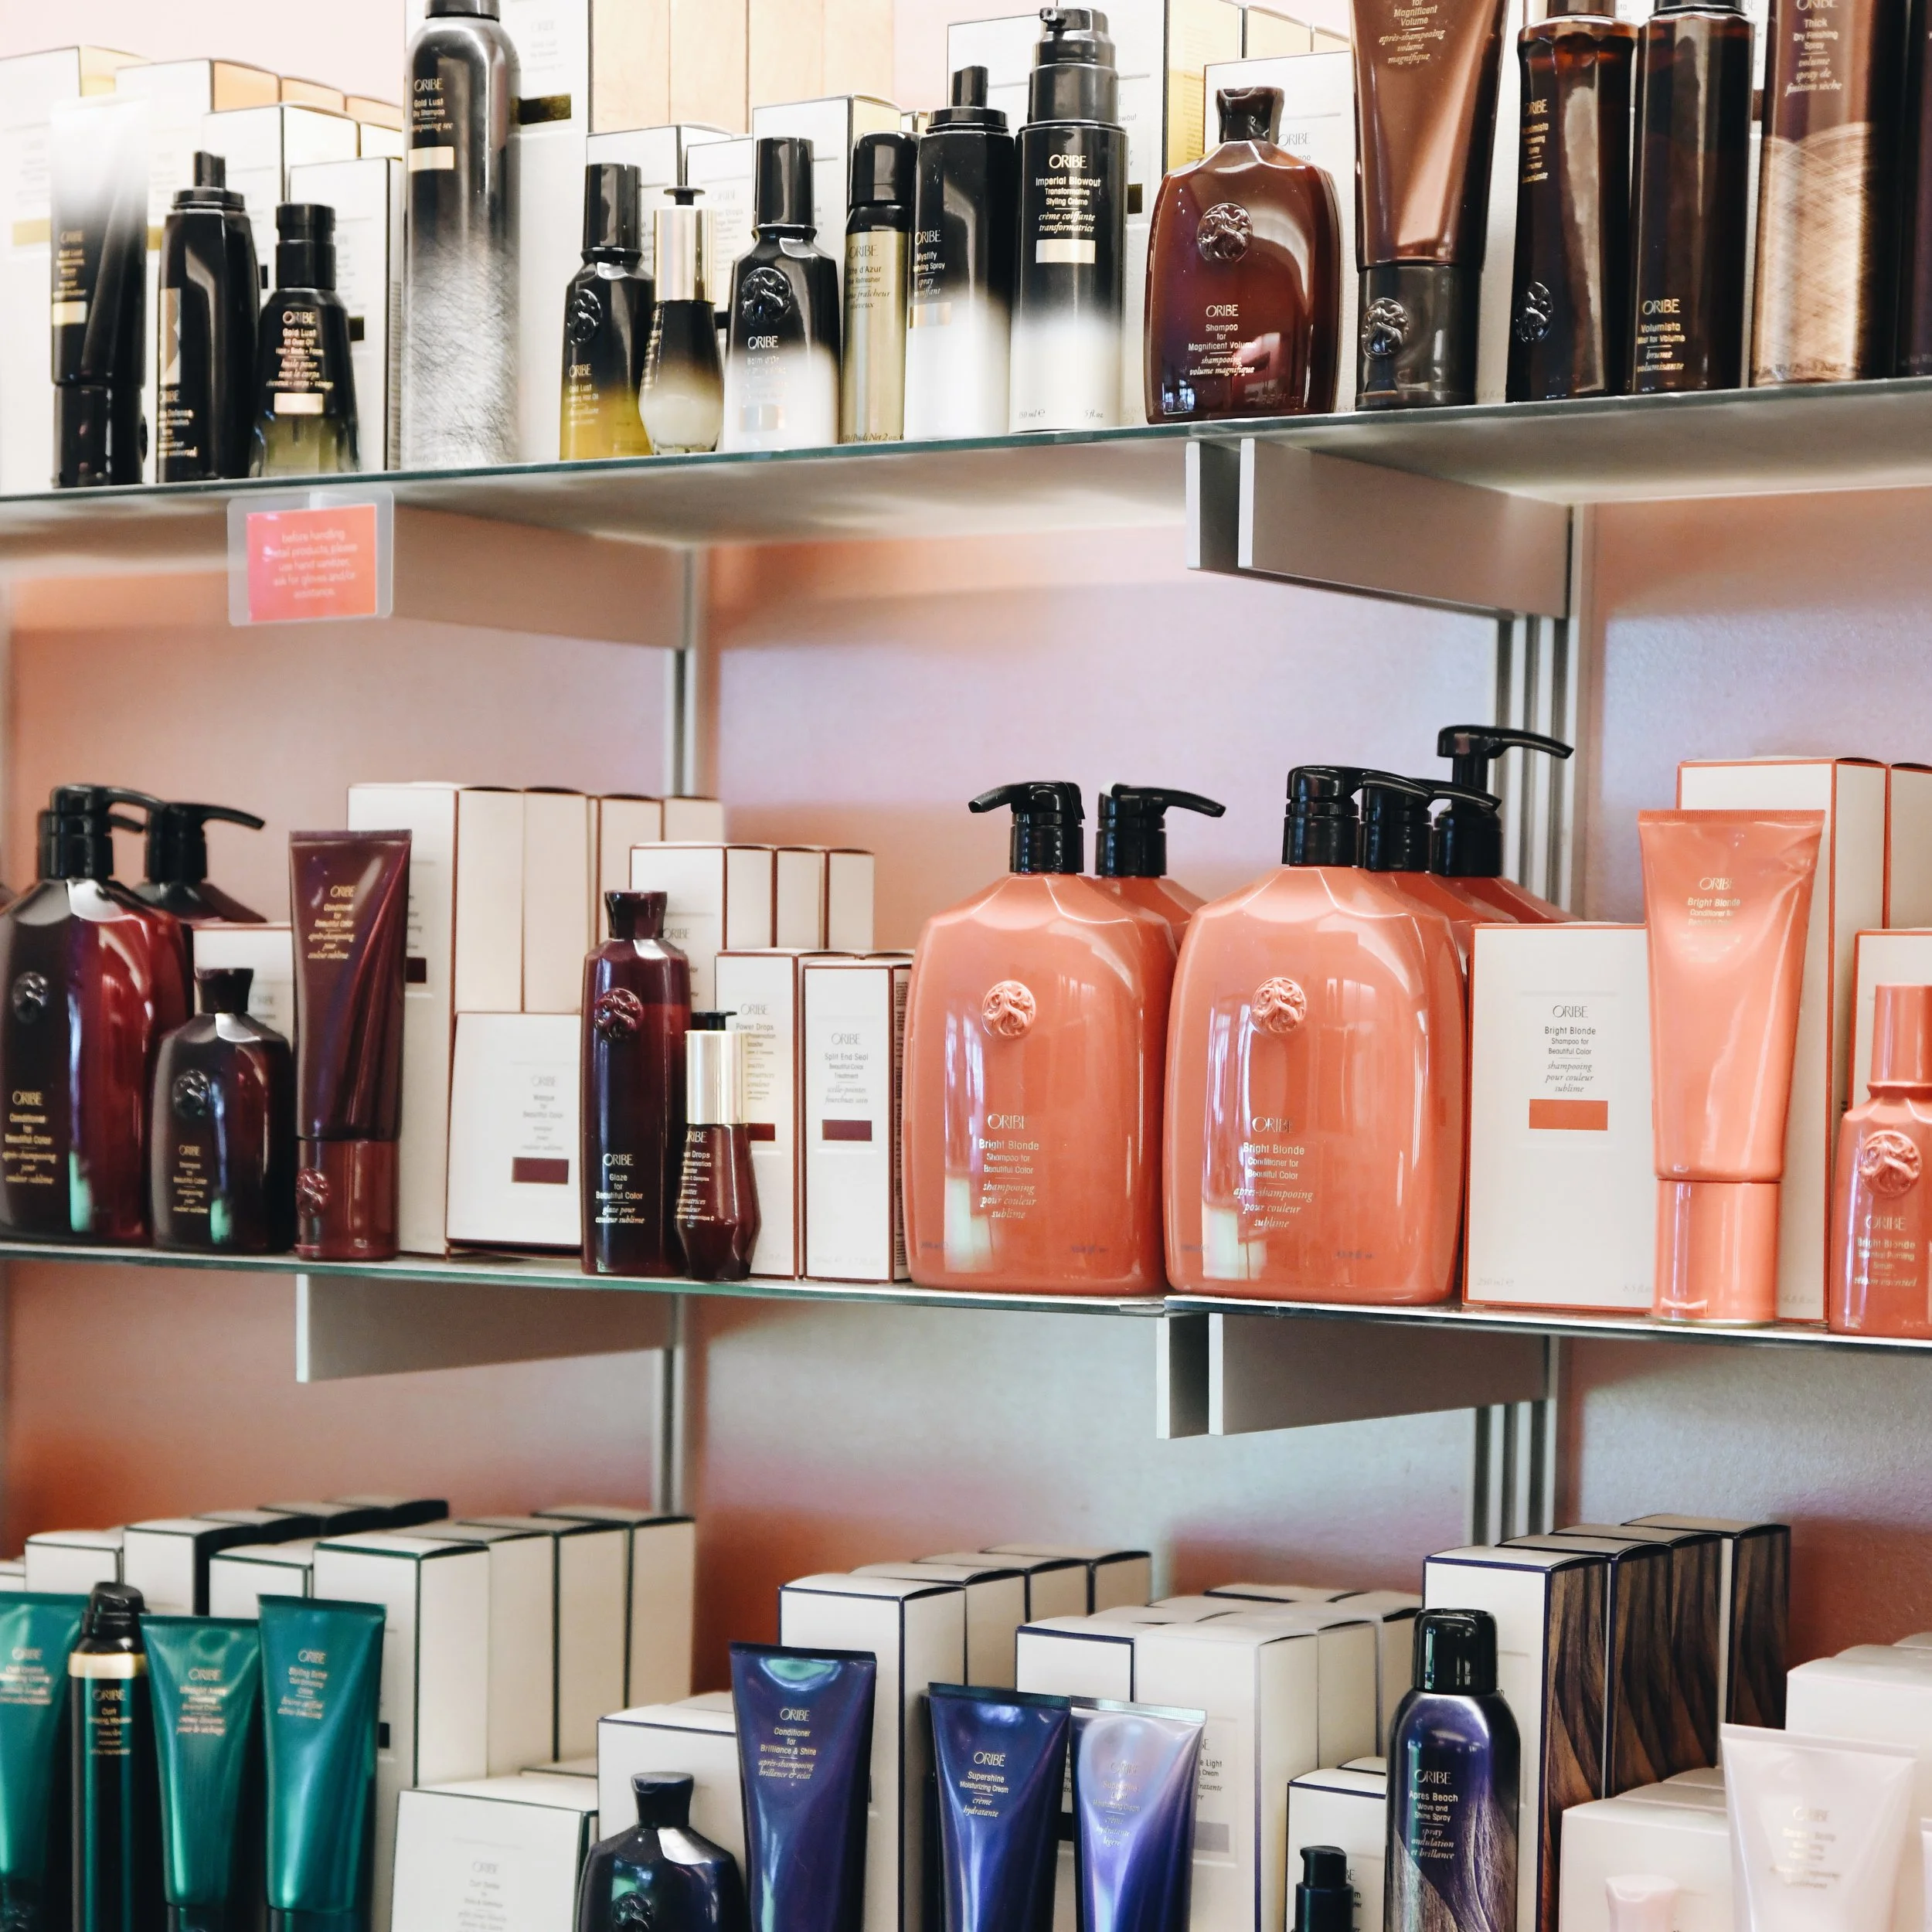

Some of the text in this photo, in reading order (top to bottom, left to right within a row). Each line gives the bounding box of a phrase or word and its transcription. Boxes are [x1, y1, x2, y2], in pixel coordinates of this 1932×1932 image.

[1394, 5, 1437, 17] Magnificent
[1401, 17, 1428, 26] Volume
[1804, 19, 1828, 28] Thick
[1379, 29, 1445, 46] après-shampooing
[1793, 31, 1838, 42] Dry Finishing
[1397, 43, 1424, 52] volume
[1804, 42, 1824, 50] Spray
[1388, 52, 1430, 65] magnifique
[415, 78, 444, 91] ORIBE
[414, 97, 444, 107] Gold Lust
[1280, 133, 1311, 147] ORIBE
[1049, 155, 1087, 168] ORIBE
[1036, 176, 1100, 187] Imperial Blowout
[1046, 198, 1066, 206] Styling
[1039, 211, 1096, 223] crème coiffante
[1039, 222, 1094, 233] transformatrice
[915, 230, 941, 245] ORIBE
[849, 244, 878, 258] ORIBE
[917, 252, 937, 261] Mystify
[918, 278, 934, 287] spray
[858, 289, 890, 300] fraîcheur
[1206, 304, 1238, 317] ORIBE
[1643, 298, 1680, 315] ORIBE
[283, 311, 315, 325] ORIBE
[1206, 324, 1238, 332] Shampoo
[1641, 322, 1681, 332] Volumista
[283, 328, 317, 338] Gold Lust
[748, 335, 779, 349] ORIBE
[1189, 342, 1227, 352] Magnificent
[1647, 349, 1672, 359] brume
[1202, 355, 1241, 366] shampooing
[570, 364, 591, 377] ORIBE
[1189, 364, 1255, 377] volume magnifique
[281, 529, 345, 543] before handling
[294, 560, 315, 570] hand
[331, 886, 355, 897] ORIBE
[1688, 897, 1740, 908] Bright Blonde
[663, 927, 689, 940] ORIBE
[740, 1004, 768, 1015] ORIBE
[1553, 1005, 1589, 1018] ORIBE
[1546, 1026, 1596, 1036] Bright Blonde
[832, 1032, 861, 1045] ORIBE
[1547, 1060, 1592, 1073] shampooing
[1545, 1073, 1594, 1083] pour couleur
[1555, 1083, 1584, 1093] sublime
[12, 1090, 43, 1105] ORIBE
[9, 1114, 46, 1124] Conditioner
[1252, 1117, 1294, 1133] ORIBE
[5, 1134, 52, 1145] Beautiful Color
[979, 1138, 1039, 1150] Bright Blonde
[179, 1145, 201, 1156] ORIBE
[1243, 1142, 1304, 1155] Bright Blonde
[604, 1153, 634, 1166] ORIBE
[692, 1151, 710, 1159] Drops
[987, 1153, 1019, 1162] Shampoo
[1248, 1157, 1287, 1167] Conditioner
[983, 1165, 1012, 1173] Beautiful
[1247, 1168, 1277, 1178] Beautiful
[983, 1181, 1034, 1195] shampooing
[595, 1191, 623, 1199] Beautiful
[1233, 1187, 1314, 1202] après-shampooing
[980, 1196, 1036, 1207] pour couleur
[602, 1205, 635, 1216] glaze pour
[992, 1208, 1026, 1219] sublime
[1243, 1202, 1301, 1214] pour couleur
[595, 1216, 645, 1224] couleur sublime
[1254, 1217, 1289, 1228] sublime
[1858, 1236, 1915, 1249] Bright Blonde
[298, 1651, 326, 1665] ORIBE
[189, 1669, 221, 1680] ORIBE
[781, 1708, 810, 1722] ORIBE
[774, 1727, 810, 1737] Conditioner
[760, 1744, 791, 1754] Brilliance
[974, 1751, 1005, 1767] ORIBE
[1206, 1759, 1222, 1768] Light
[759, 1767, 787, 1778] brillance
[968, 1771, 1005, 1784] Supershine
[1414, 1770, 1451, 1785] ORIBE
[960, 1781, 991, 1792] Moisturizing
[1104, 1779, 1139, 1791] Supershine
[972, 1797, 992, 1805] crème
[1433, 1793, 1458, 1802] Beach
[963, 1805, 998, 1818] hydratante
[1417, 1803, 1434, 1811] Wave
[1414, 1811, 1451, 1822] Shine Spray
[1422, 1827, 1442, 1839] spray
[1411, 1838, 1454, 1849] ondulation
[1420, 1849, 1454, 1859] brillance
